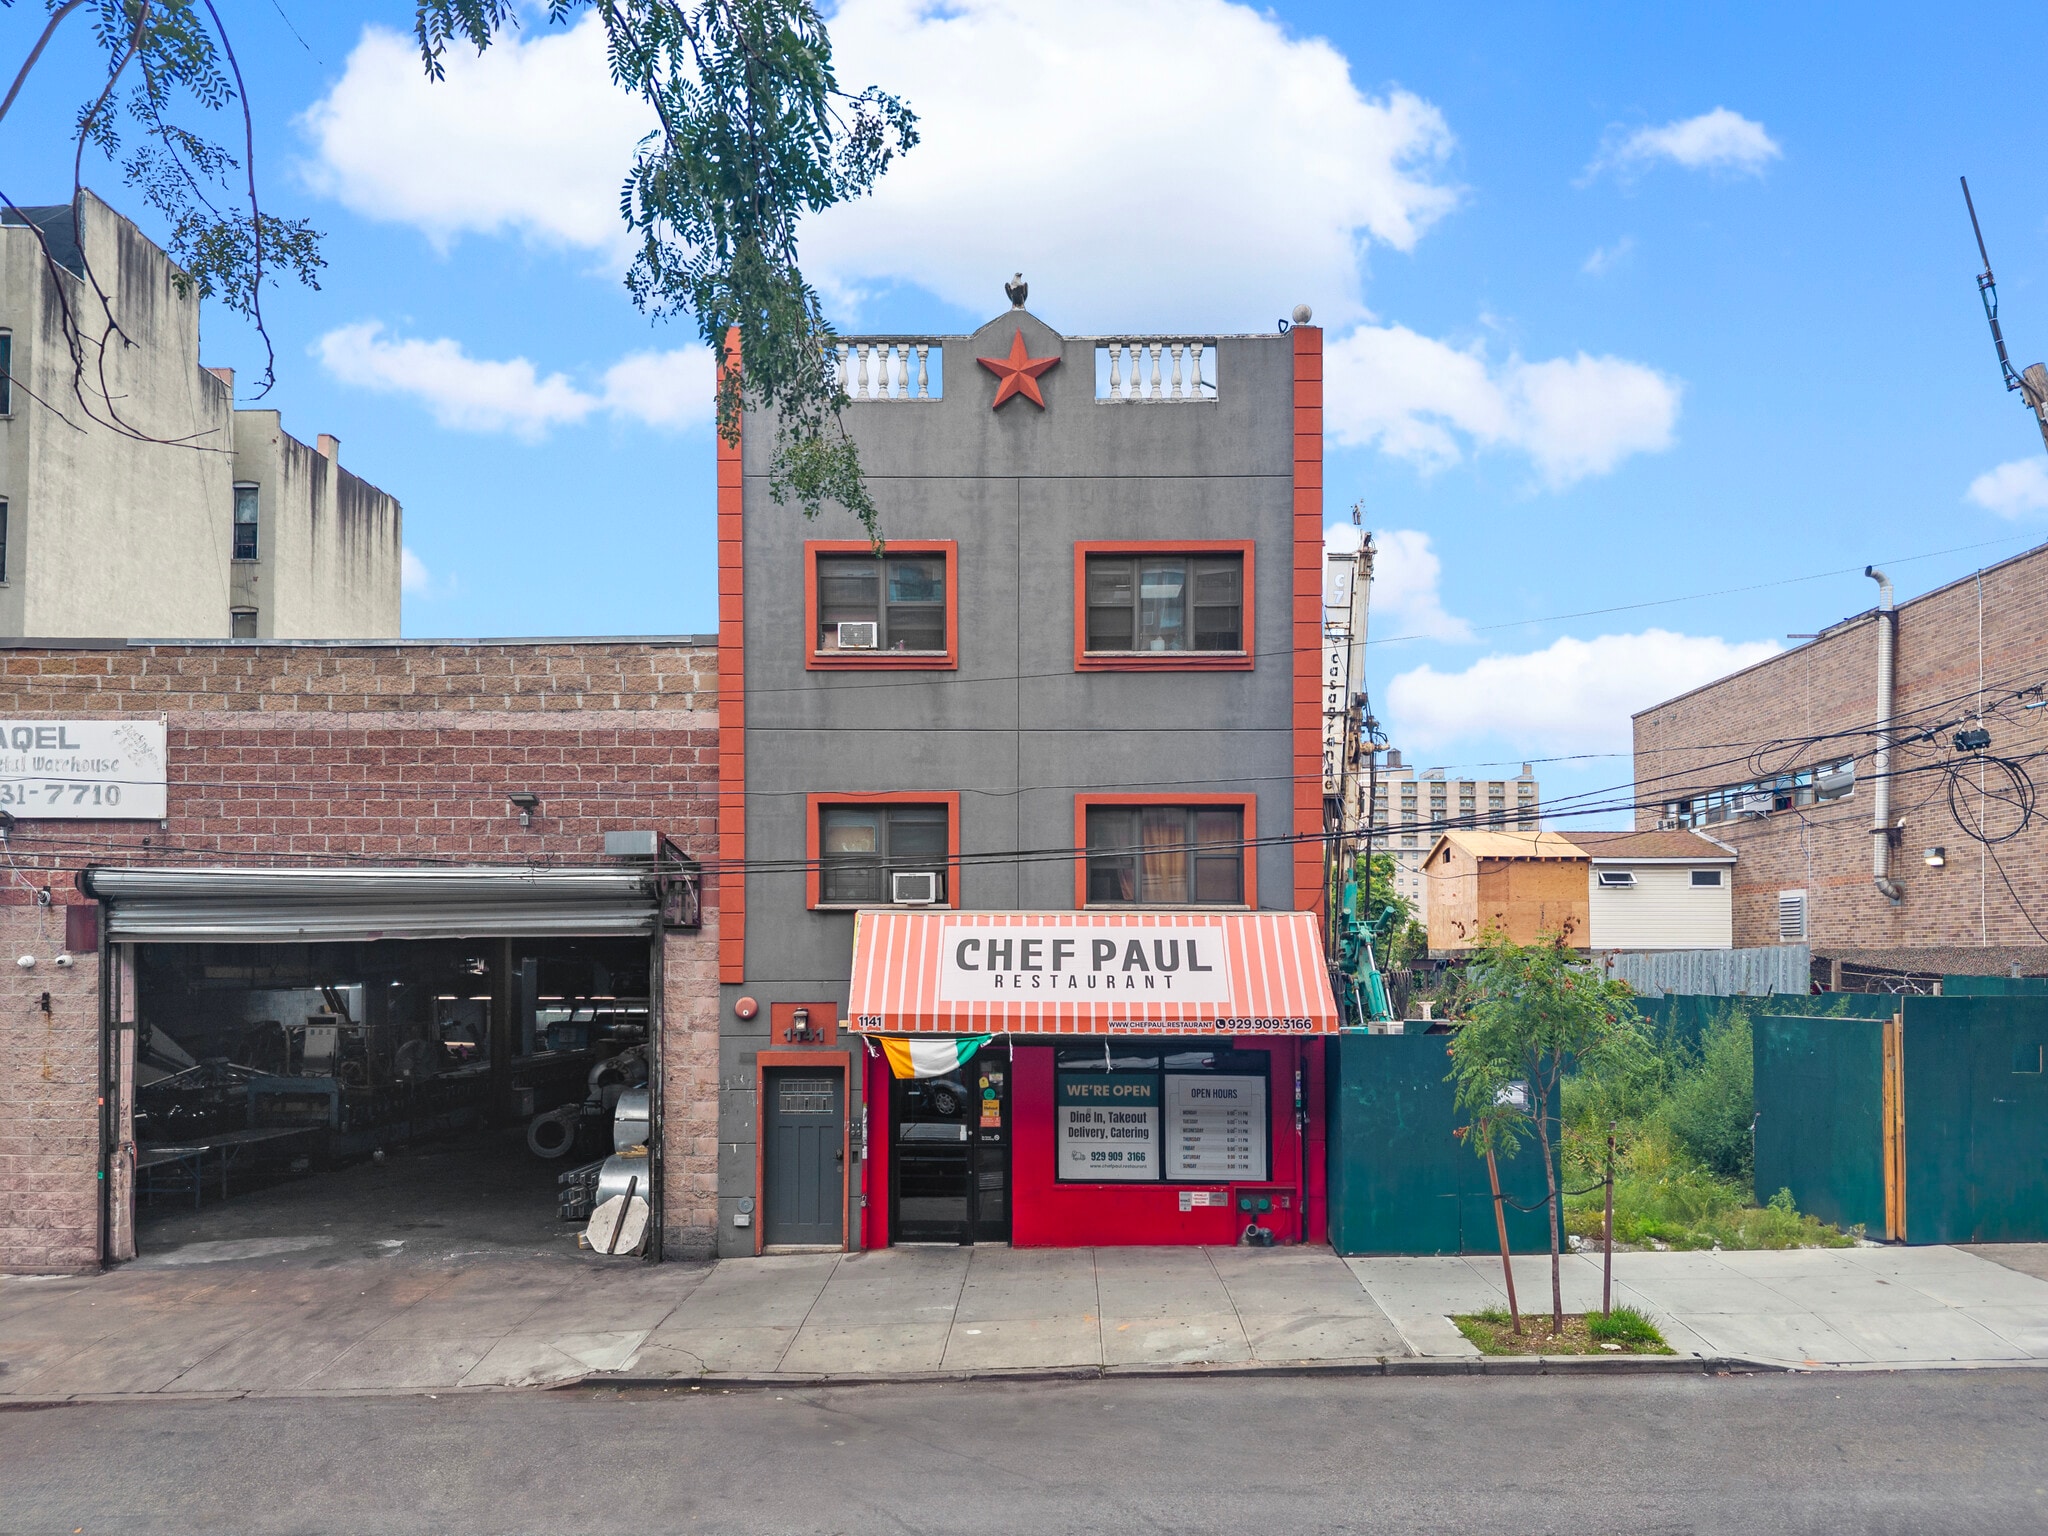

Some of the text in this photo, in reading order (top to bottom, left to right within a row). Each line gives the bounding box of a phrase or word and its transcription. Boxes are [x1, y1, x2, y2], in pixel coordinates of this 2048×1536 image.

[956, 938, 1212, 972] CHEF PAUL
[995, 974, 1173, 989] RESTAURANT
[858, 1016, 882, 1027] 1141
[1228, 1018, 1312, 1030] 929.909.3166
[784, 1027, 825, 1042] 1141
[1067, 1085, 1151, 1096] WE'RE OPEN
[1191, 1088, 1238, 1099] OPEN HOURS
[1070, 1111, 1147, 1124] Dine In, Takeout
[1068, 1126, 1149, 1139] Delivery, Catering
[1091, 1151, 1146, 1162] 929 909 3166
